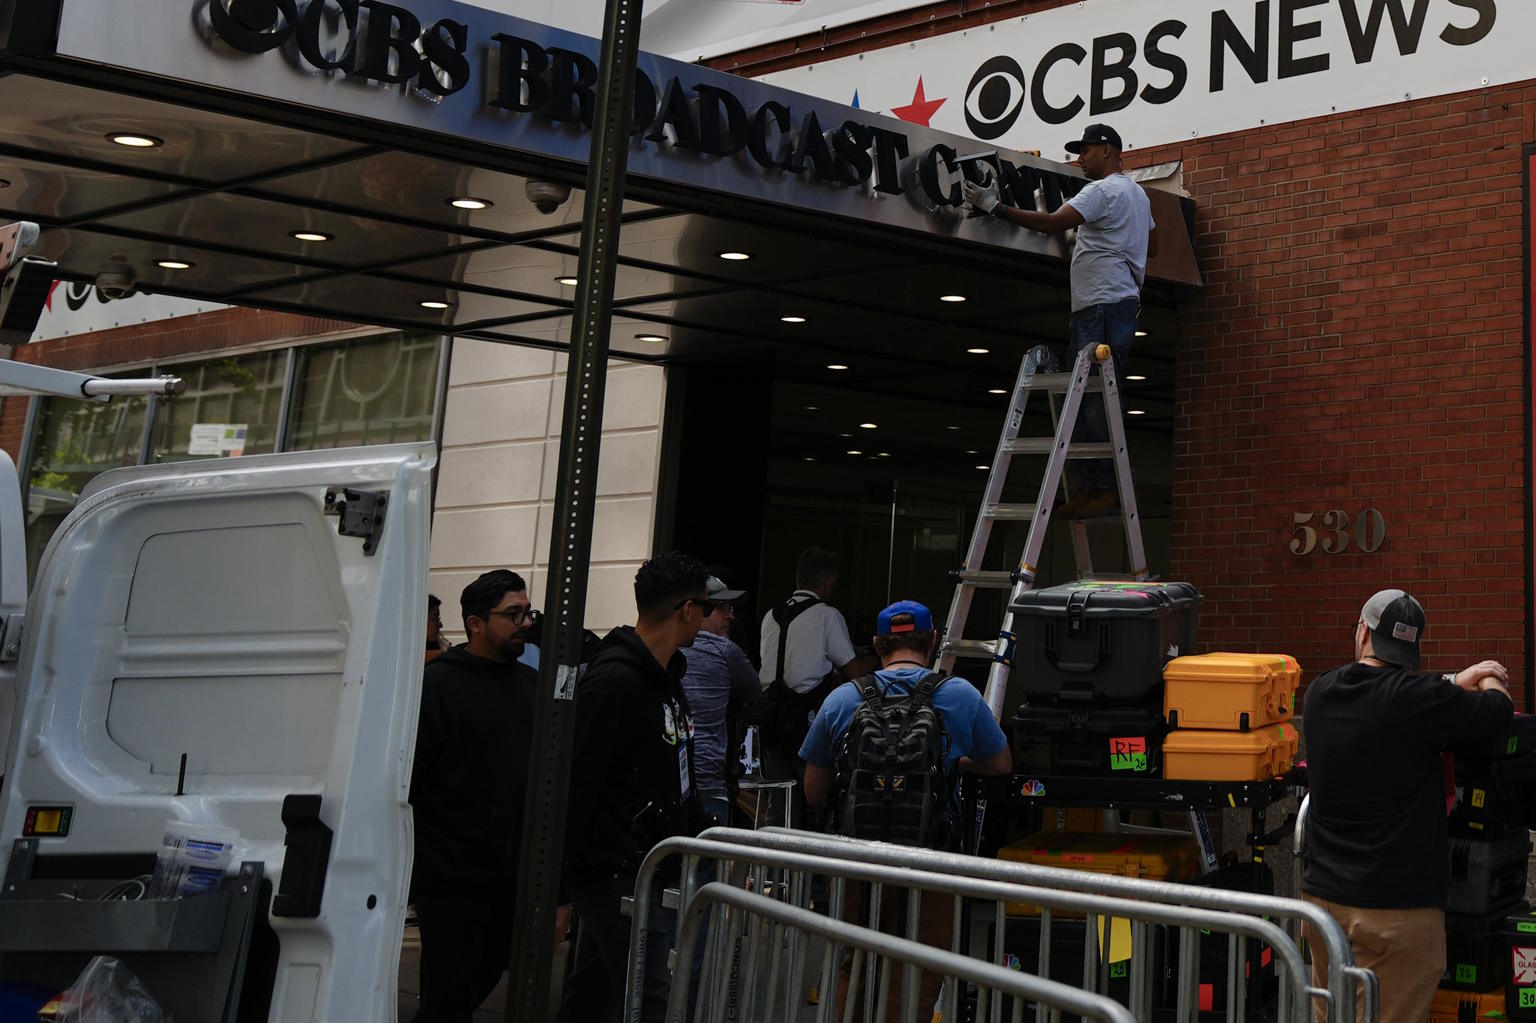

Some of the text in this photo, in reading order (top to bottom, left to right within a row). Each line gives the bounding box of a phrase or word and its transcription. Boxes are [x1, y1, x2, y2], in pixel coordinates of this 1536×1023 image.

[1031, 19, 1187, 125] CBS
[1289, 508, 1385, 555] 530
[1115, 740, 1141, 764] RF
[1523, 992, 1534, 1005] 30
